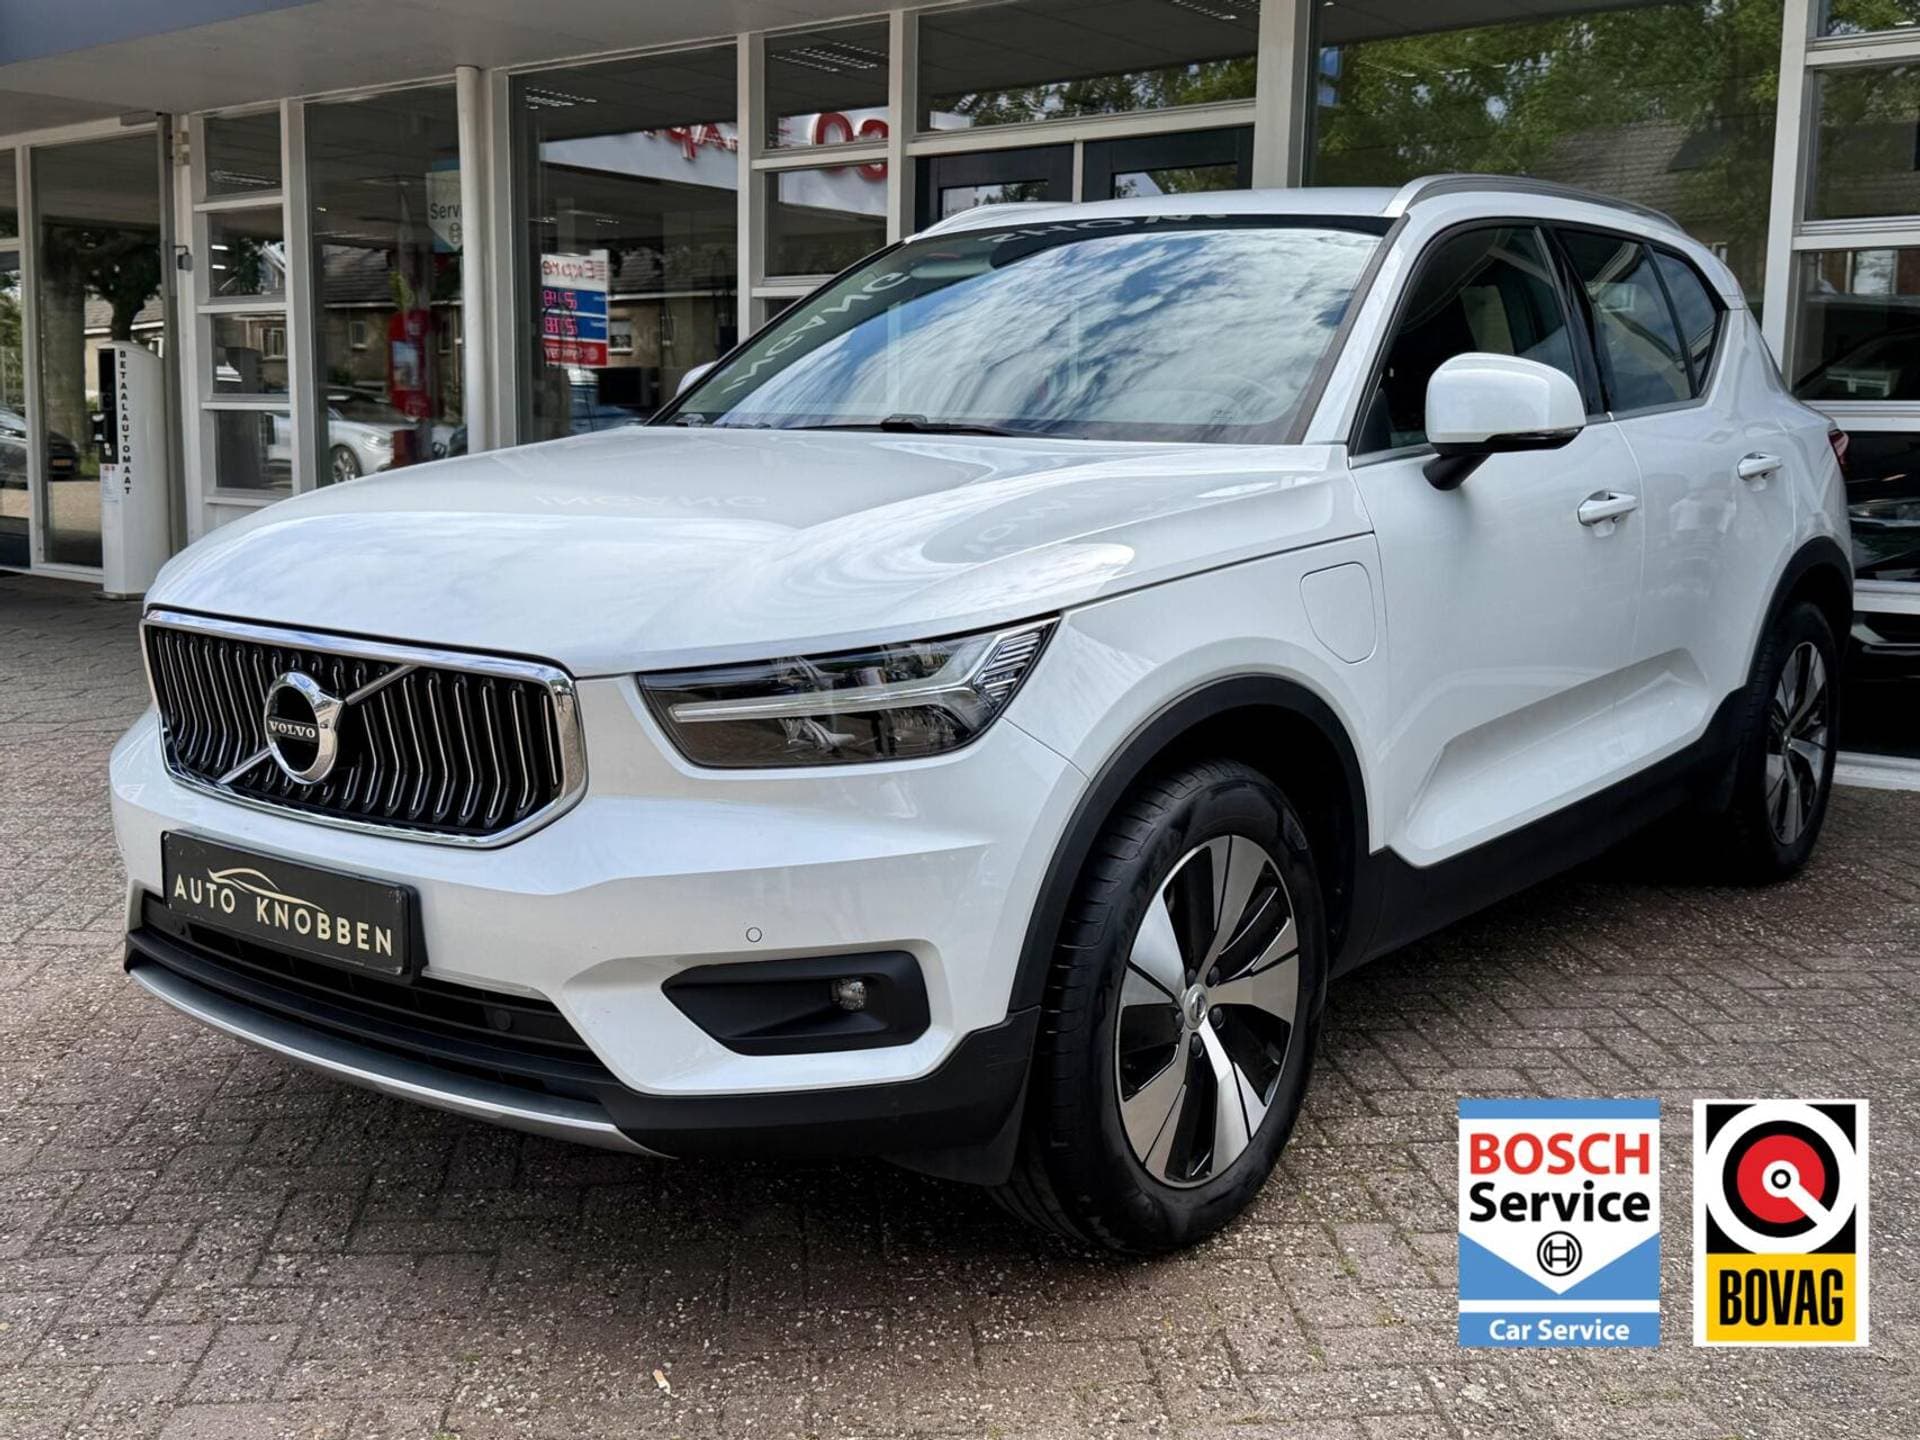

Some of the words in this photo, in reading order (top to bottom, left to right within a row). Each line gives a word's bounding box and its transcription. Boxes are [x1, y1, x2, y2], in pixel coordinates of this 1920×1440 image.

[119, 350, 132, 495] BETAALAUTOMAAT
[268, 720, 316, 739] VOLVO
[173, 873, 237, 915] AUTO
[255, 896, 393, 957] KNOBBEN
